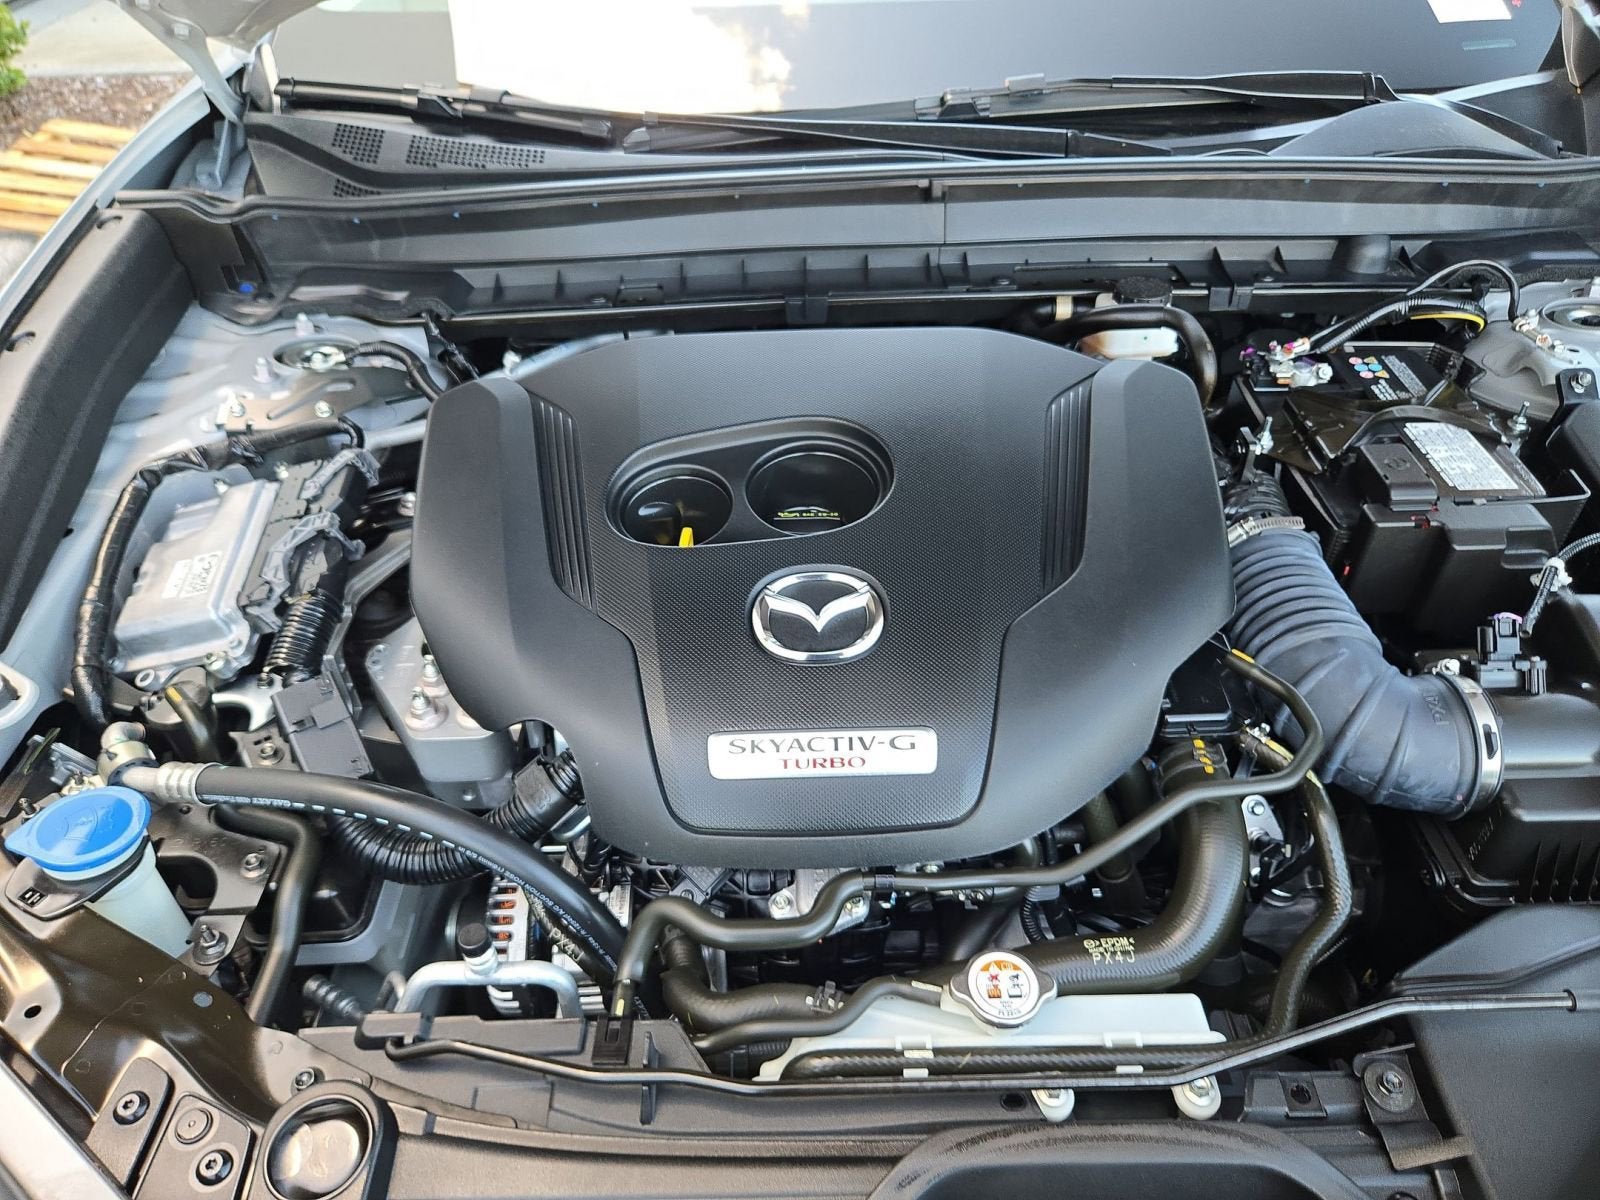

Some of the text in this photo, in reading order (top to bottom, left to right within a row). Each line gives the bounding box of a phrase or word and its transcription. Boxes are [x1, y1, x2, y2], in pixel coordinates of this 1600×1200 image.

[728, 734, 917, 755] SKYACTIV-G
[778, 756, 867, 770] TURBO
[504, 870, 526, 886] HOSE
[524, 883, 554, 906] SUCTION
[553, 904, 566, 916] A/C
[548, 927, 585, 962] PX4J
[1092, 950, 1136, 966] PX4J
